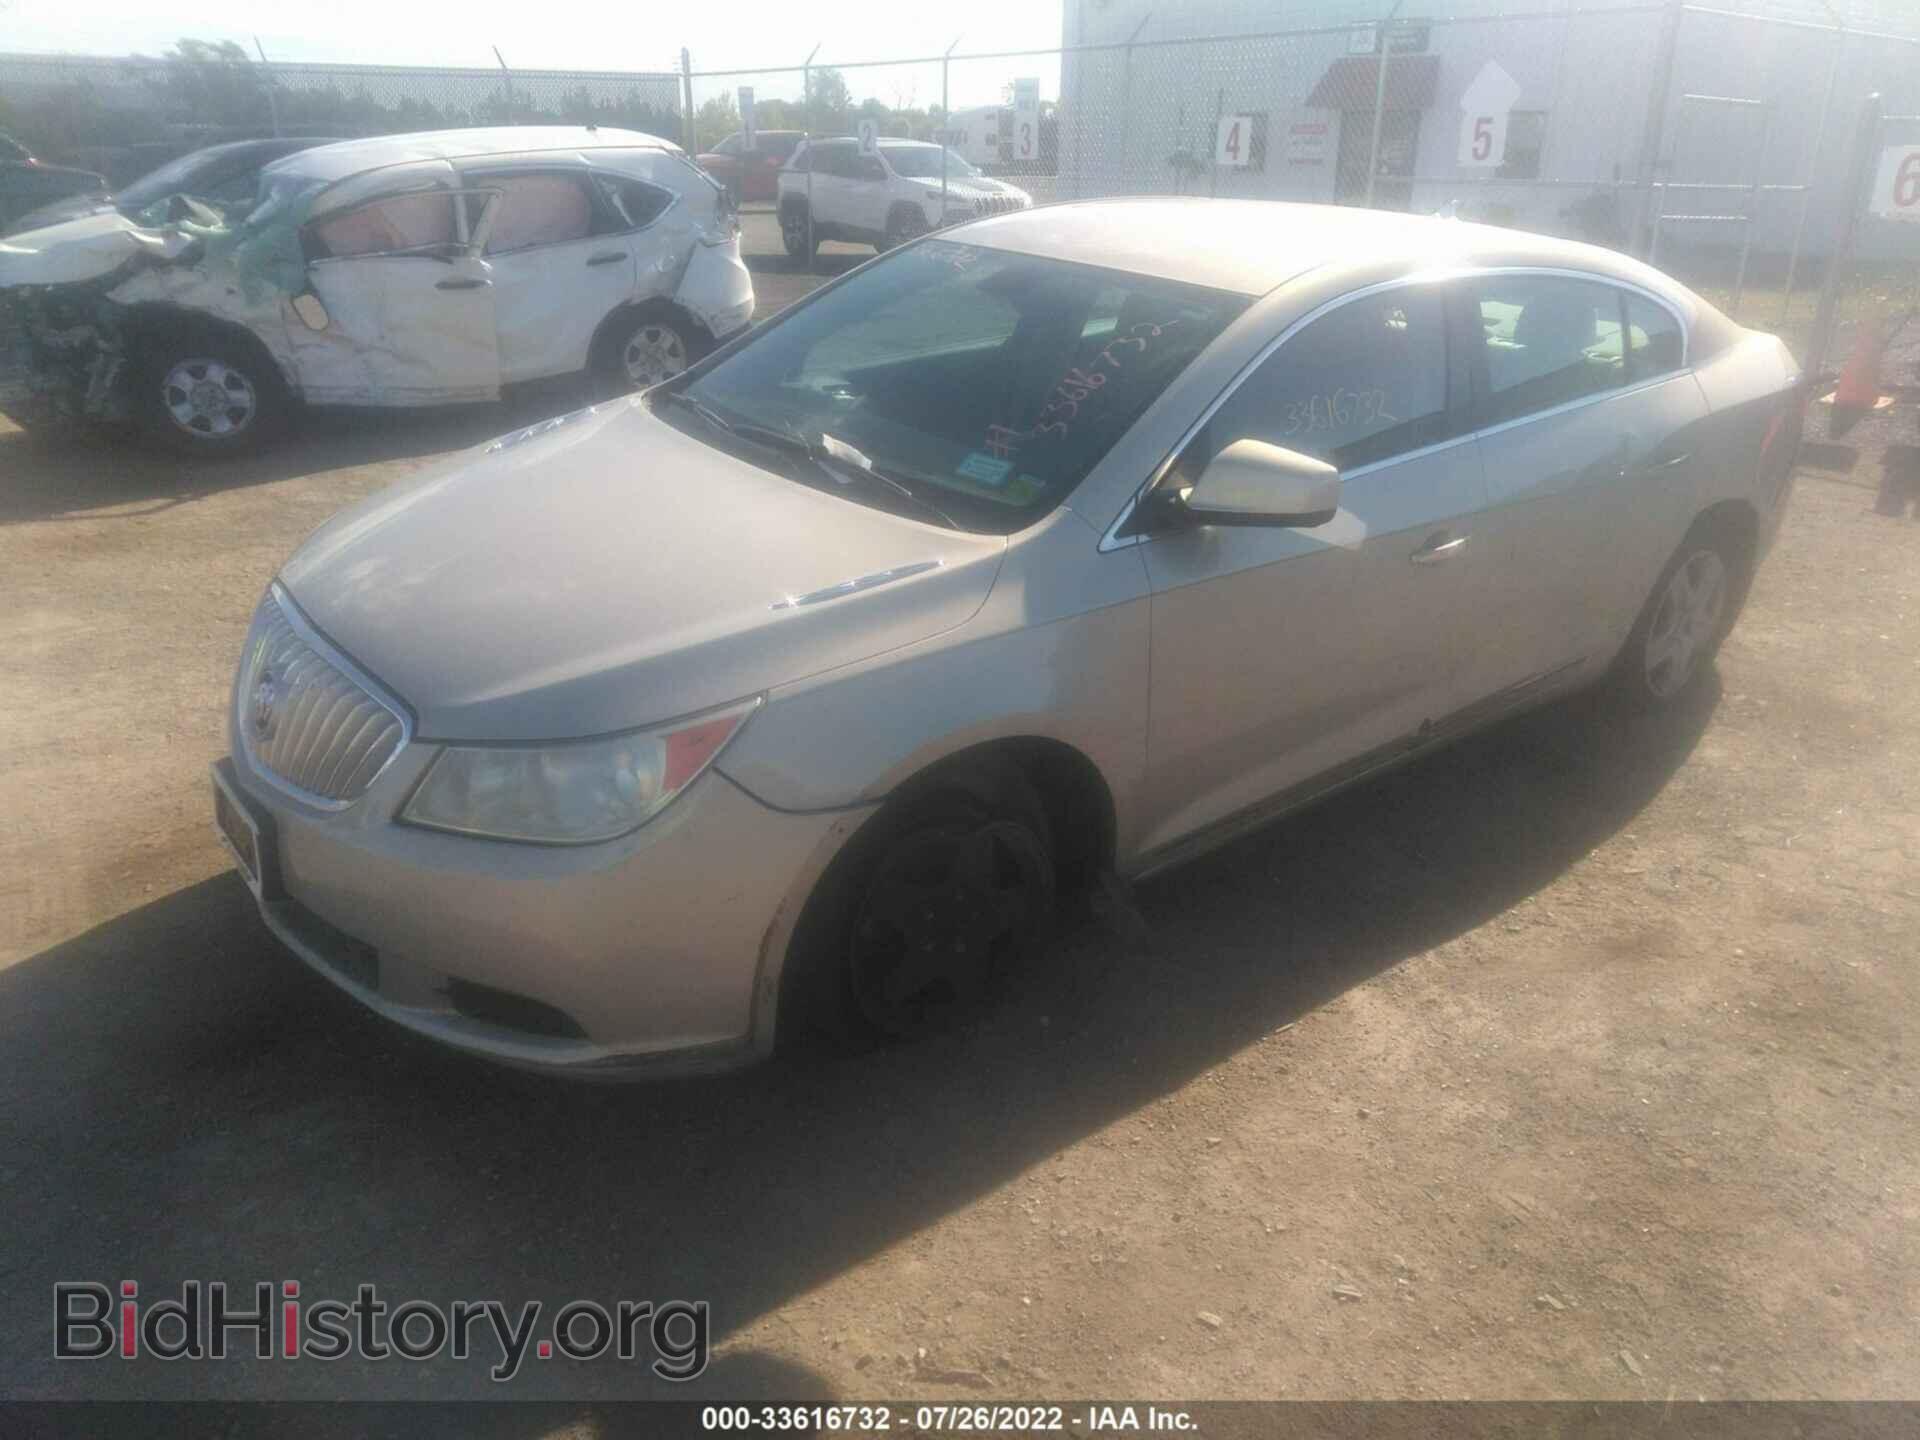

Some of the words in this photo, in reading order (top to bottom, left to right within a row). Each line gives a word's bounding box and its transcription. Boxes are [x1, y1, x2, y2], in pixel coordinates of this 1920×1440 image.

[862, 122, 874, 153] 2
[1020, 121, 1032, 157] 3
[1224, 121, 1241, 161] 4
[1471, 116, 1494, 161] 5
[1893, 152, 1920, 207] 6
